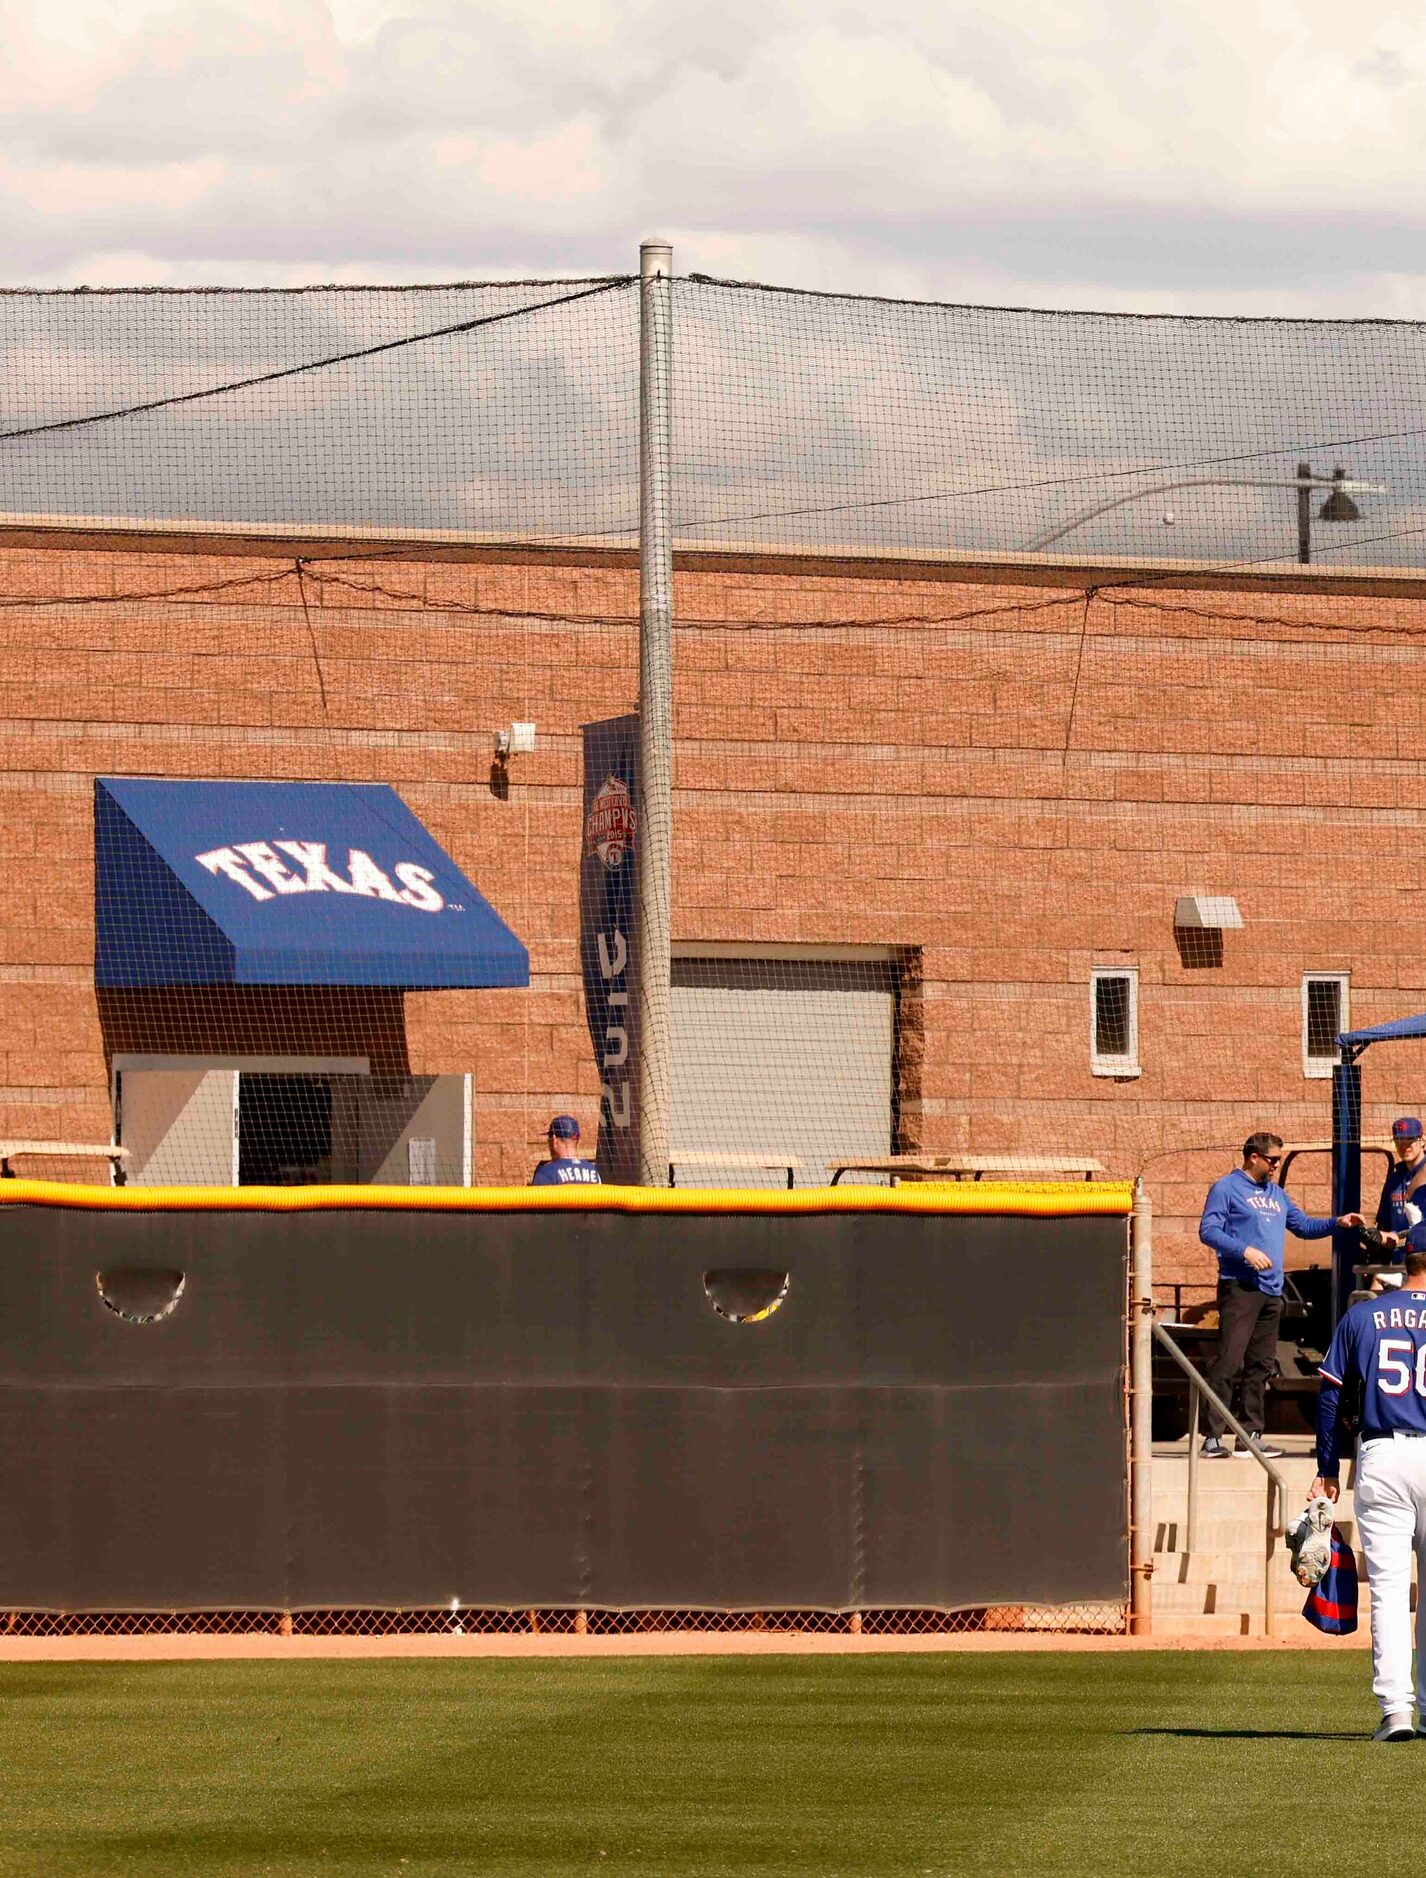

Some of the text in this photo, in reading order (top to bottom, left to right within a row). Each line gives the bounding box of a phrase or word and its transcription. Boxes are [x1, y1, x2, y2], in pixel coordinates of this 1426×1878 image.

[194, 840, 444, 912] TEXAS
[557, 1167, 602, 1184] HEANE
[1247, 1196, 1281, 1212] TEXAS
